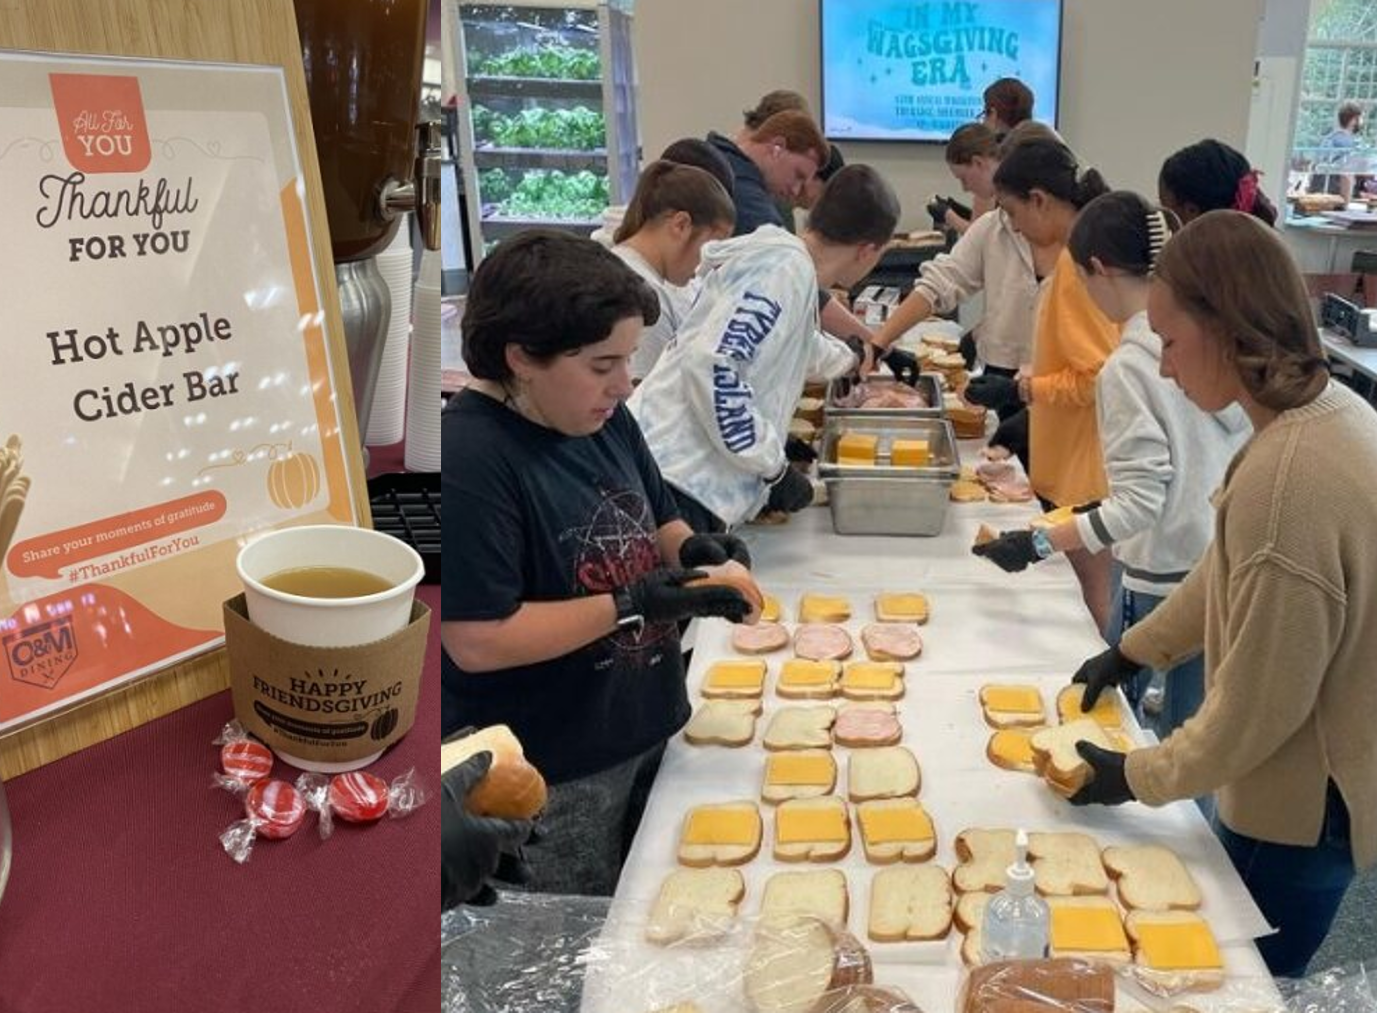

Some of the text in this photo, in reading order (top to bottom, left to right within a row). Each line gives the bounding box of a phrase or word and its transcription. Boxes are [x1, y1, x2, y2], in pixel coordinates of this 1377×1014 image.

[942, 0, 979, 24] MY
[867, 19, 1019, 61] WAGSGIVING
[911, 55, 971, 89] ERA
[73, 110, 133, 133] All For
[77, 135, 133, 156] YOU
[36, 171, 199, 230] Thankful
[69, 230, 191, 262] FOR YOU
[46, 312, 233, 365] Hot Apple
[73, 371, 240, 422] Cider Bar
[714, 364, 756, 453] ISLAND
[22, 501, 216, 563] Share your moments of gratitude
[69, 535, 200, 583] #ThankfulForYou
[12, 627, 73, 667] O&M
[20, 653, 73, 678] DINING
[253, 675, 403, 714] FRIENDSGIVING
[290, 677, 367, 697] HAPPY
